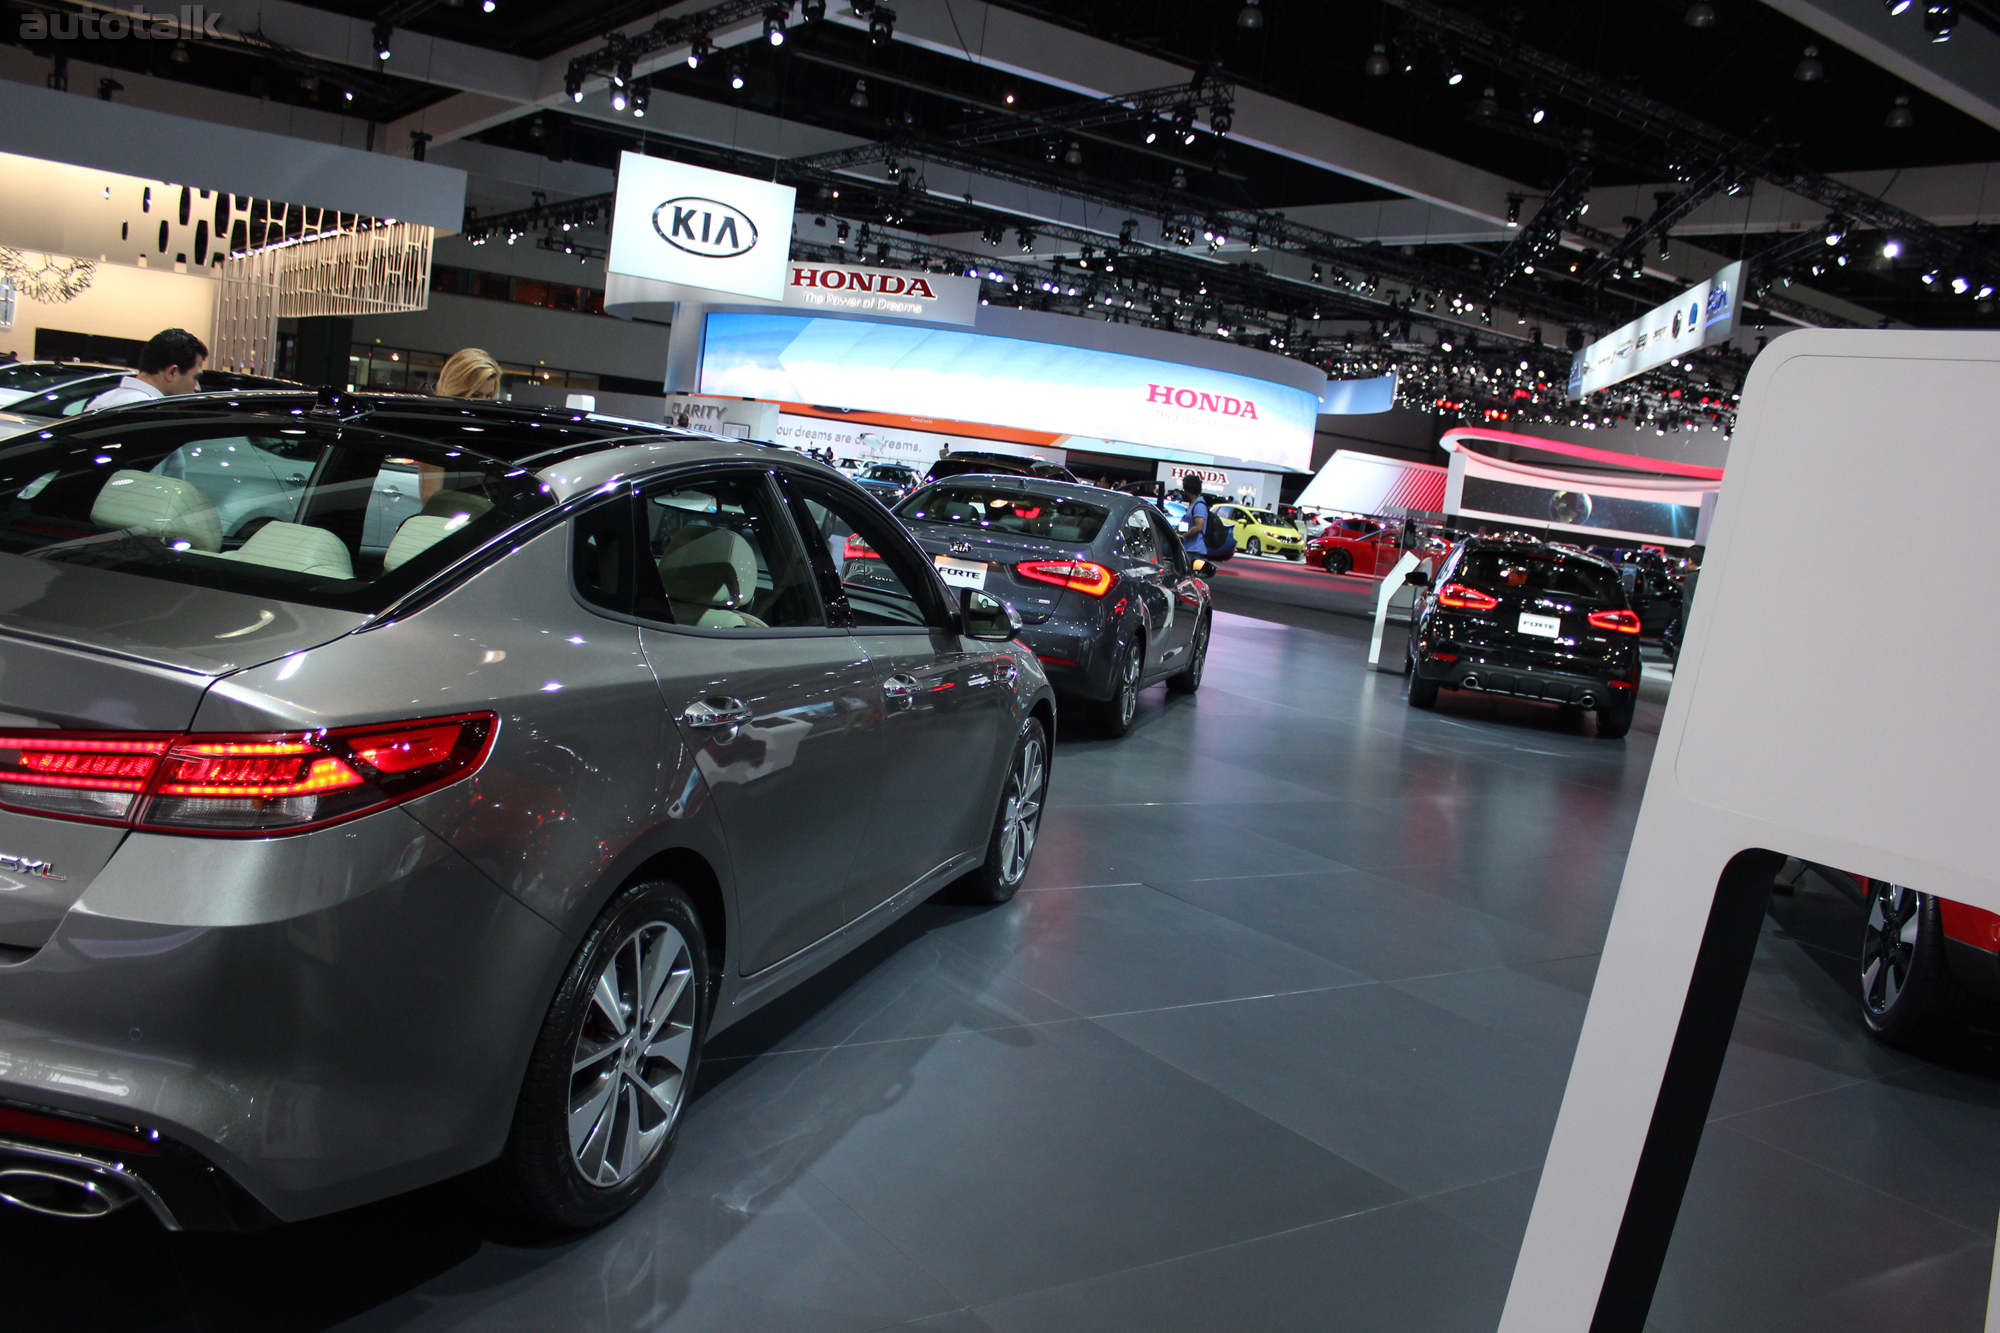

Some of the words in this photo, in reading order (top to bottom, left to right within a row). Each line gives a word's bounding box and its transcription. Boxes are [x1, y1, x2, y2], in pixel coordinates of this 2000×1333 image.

[671, 205, 739, 249] KIA
[790, 267, 938, 300] HONDA
[803, 291, 823, 304] The
[825, 293, 861, 308] Power
[862, 297, 875, 309] of
[877, 298, 923, 314] Dreams
[1146, 383, 1258, 420] HONDA
[672, 402, 728, 421] CLARITY
[794, 425, 832, 441] dreams
[834, 433, 852, 444] are
[1171, 467, 1229, 484] HONDA
[938, 566, 981, 580] FORTE
[1523, 620, 1556, 631] FORTE
